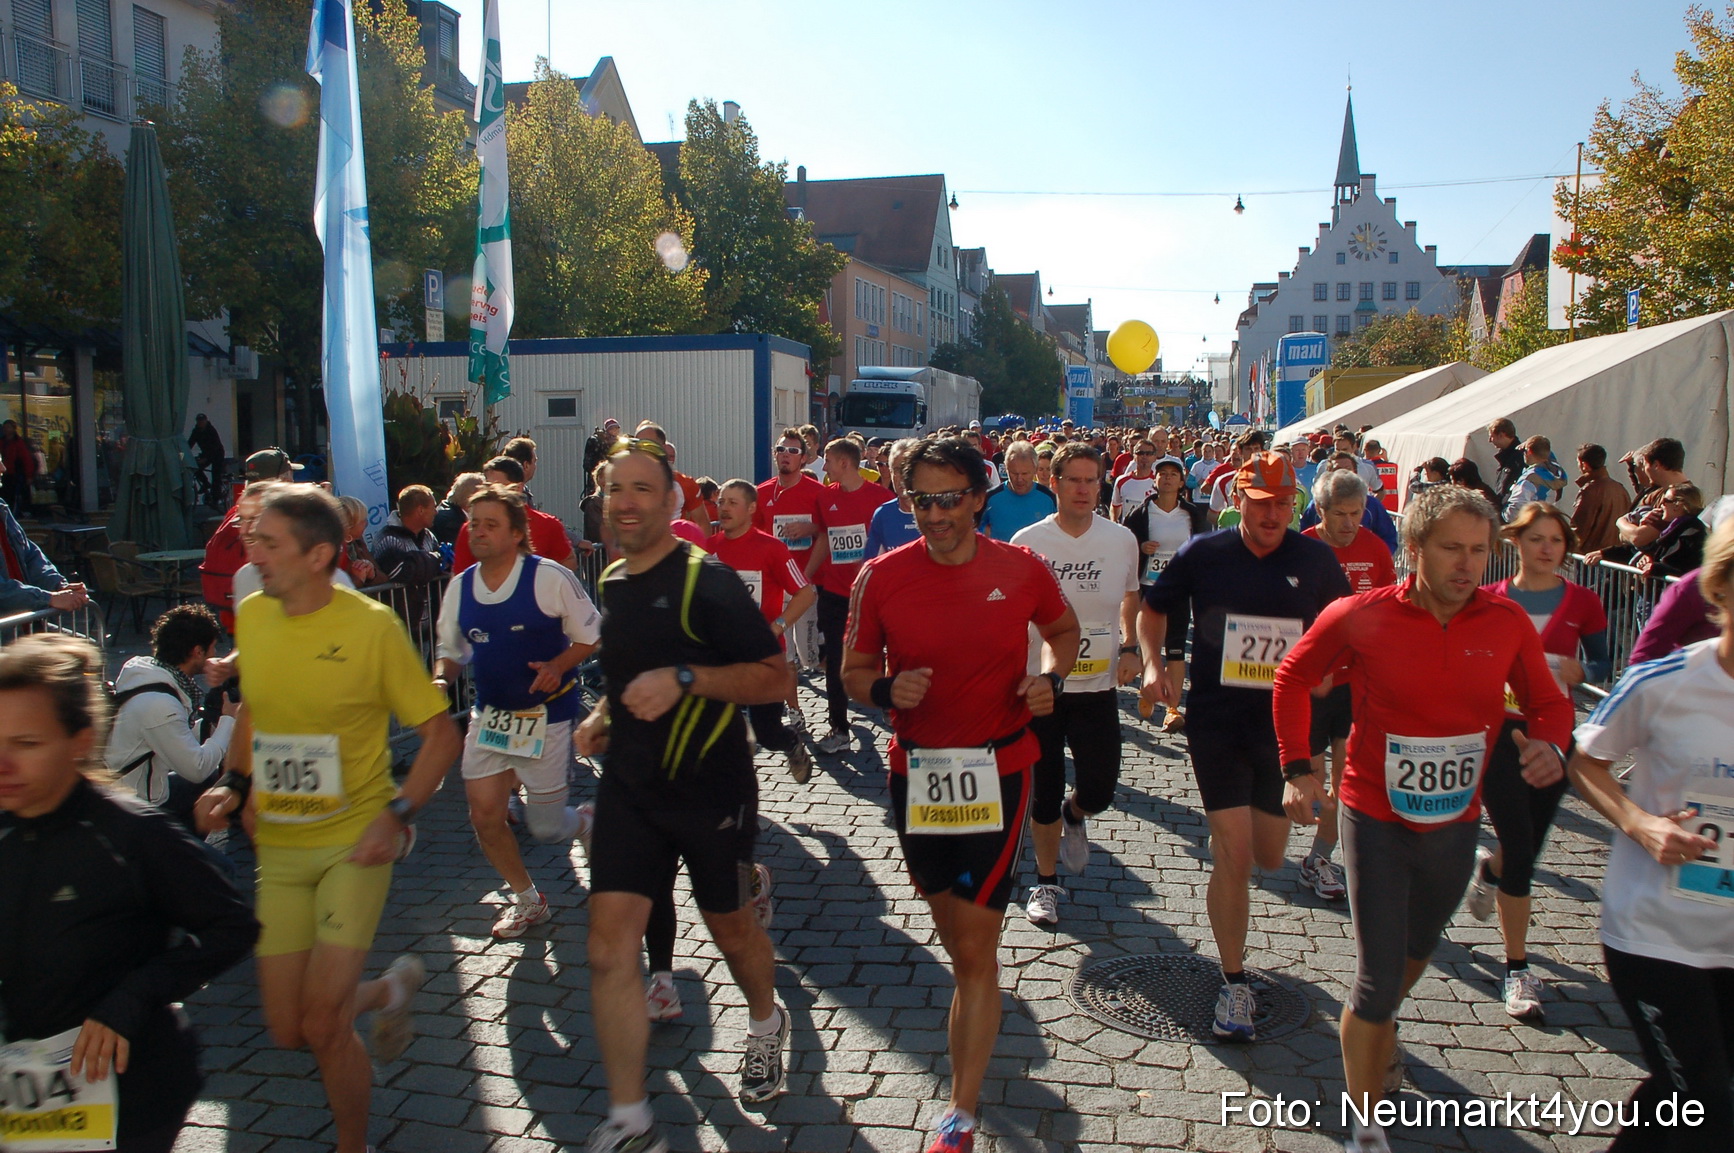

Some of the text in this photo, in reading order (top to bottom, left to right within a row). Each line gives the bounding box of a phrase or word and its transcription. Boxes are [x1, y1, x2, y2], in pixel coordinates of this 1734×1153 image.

[428, 274, 439, 303] P
[1629, 294, 1637, 320] P
[1288, 341, 1323, 360] maxi
[832, 534, 863, 551] 2909
[1051, 560, 1096, 572] Lauf
[1058, 569, 1103, 581] Treff
[1241, 635, 1287, 661] 272
[487, 708, 539, 737] 3317
[1401, 743, 1447, 754] PFLEIDERER
[264, 757, 322, 793] 905
[1397, 756, 1476, 794] 2866
[927, 771, 978, 803] 810
[919, 804, 990, 823] Vassilios
[1405, 792, 1466, 813] Werner
